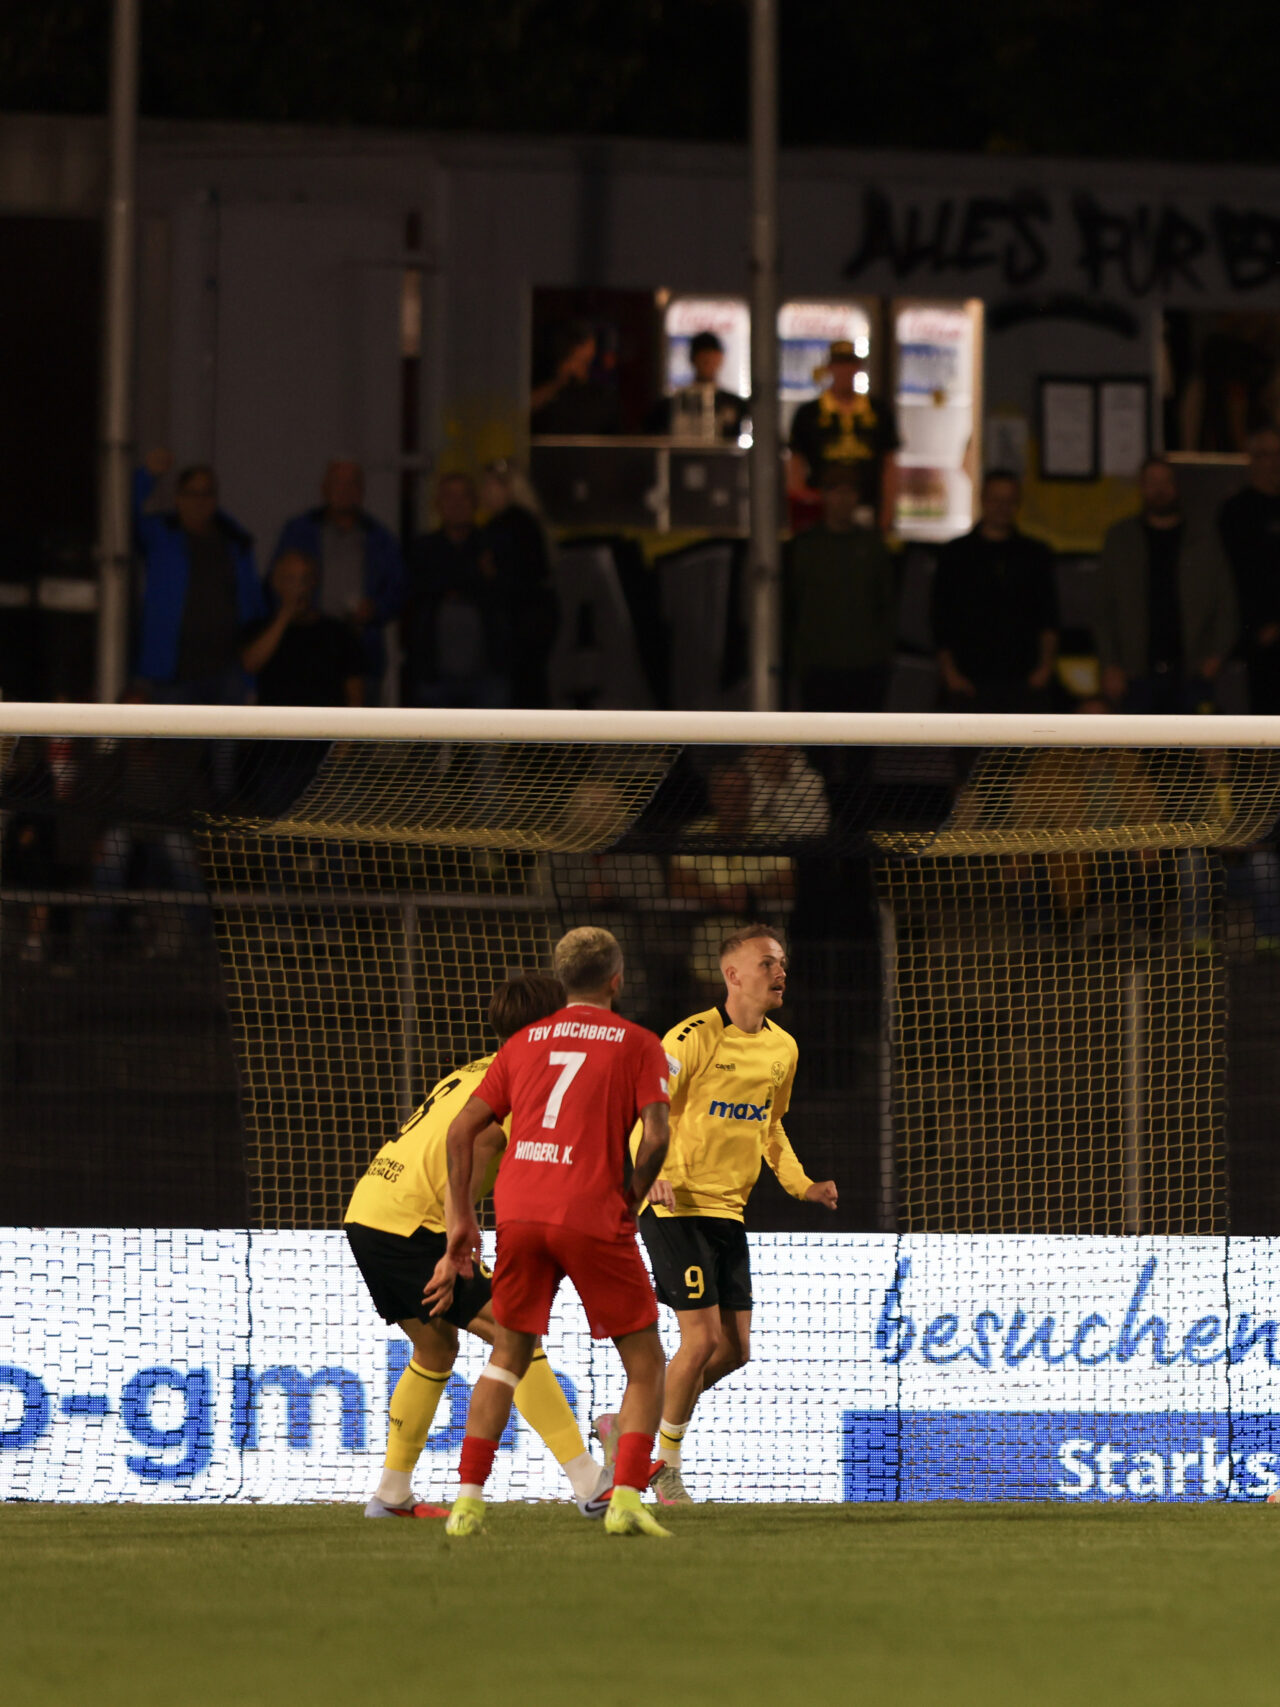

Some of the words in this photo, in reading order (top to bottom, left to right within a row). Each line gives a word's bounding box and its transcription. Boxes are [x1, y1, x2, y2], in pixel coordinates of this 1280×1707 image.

[844, 184, 1051, 285] ALLES
[528, 1025, 552, 1043] TSV
[552, 1021, 627, 1043] BUCHBACH
[541, 1051, 588, 1129] 7
[684, 1265, 705, 1299] 9
